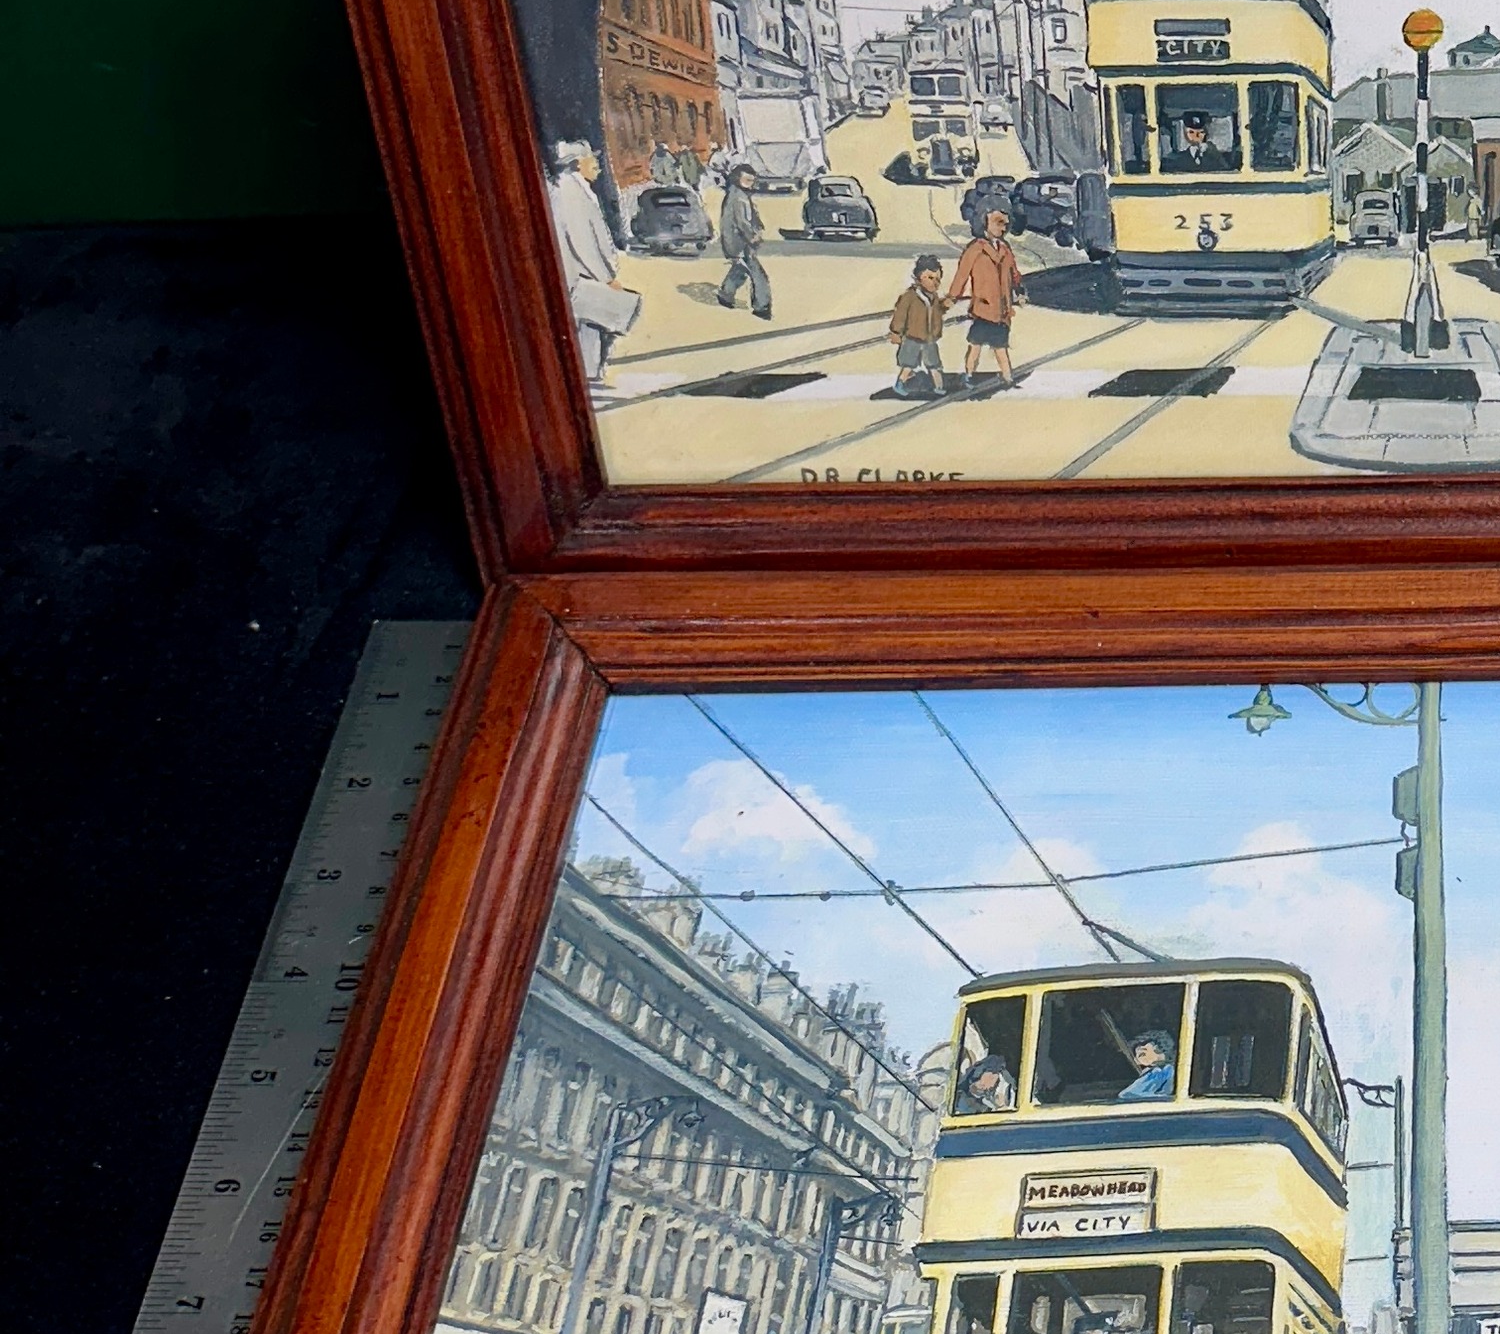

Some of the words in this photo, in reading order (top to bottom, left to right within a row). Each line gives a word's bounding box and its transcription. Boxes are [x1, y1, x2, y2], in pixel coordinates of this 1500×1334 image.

[1165, 40, 1221, 57] CITY
[1174, 212, 1234, 231] 253
[347, 777, 372, 788] 2
[317, 869, 342, 880] 3
[368, 886, 387, 895] 8
[356, 924, 375, 933] 9
[284, 966, 309, 978] 4
[335, 962, 365, 991] 10
[326, 1005, 348, 1024] 11
[313, 1047, 336, 1067] 12
[251, 1069, 278, 1083] 5
[287, 1132, 310, 1152] 14
[214, 1178, 241, 1193] 6
[274, 1176, 296, 1197] 15
[1028, 1180, 1147, 1201] MEADOWHEAD
[259, 1221, 282, 1243] 16
[1027, 1220, 1060, 1233] VIA
[1075, 1215, 1131, 1232] CITY
[245, 1267, 268, 1289] 17
[176, 1295, 206, 1310] 7
